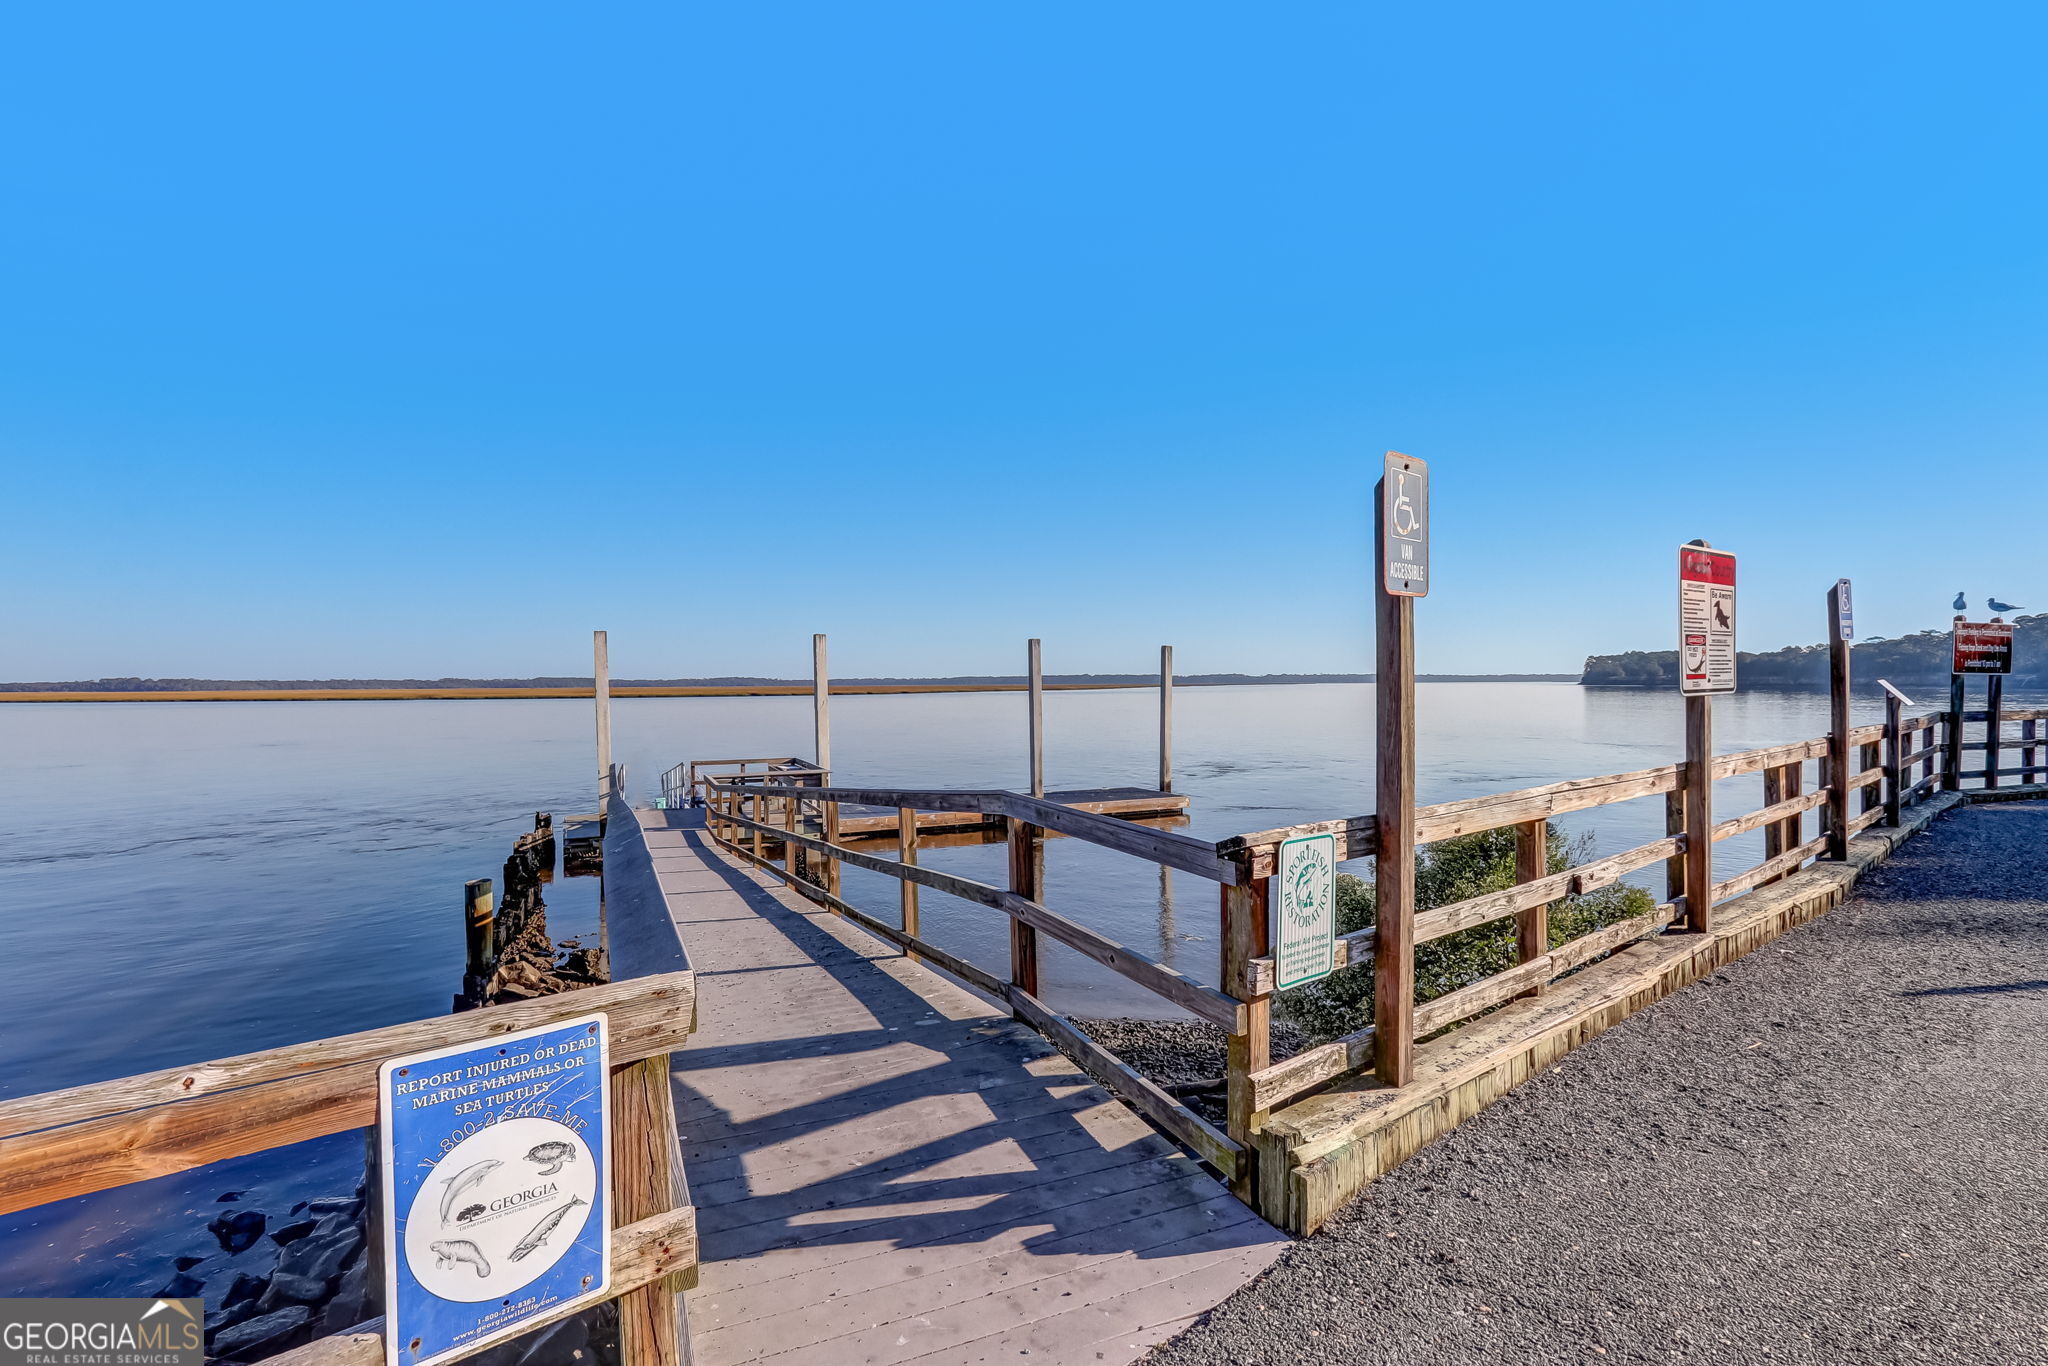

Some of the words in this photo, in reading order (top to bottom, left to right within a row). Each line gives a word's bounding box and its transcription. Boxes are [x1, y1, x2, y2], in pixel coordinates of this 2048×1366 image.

[1401, 543, 1413, 560] VAN
[1390, 561, 1424, 581] ACCESSIBLE
[1711, 590, 1718, 598] Be
[1719, 592, 1732, 600] Aware
[1284, 883, 1330, 928] RESTORATION
[1283, 940, 1300, 950] Federal
[1312, 931, 1329, 942] Project
[396, 1070, 463, 1096] REPORT
[466, 1053, 530, 1078] INJURED
[534, 1046, 554, 1060] OR
[558, 1036, 597, 1054] DEAD
[412, 1082, 479, 1110] MARINE
[482, 1062, 561, 1091] MAMMALS
[564, 1056, 585, 1069] OR
[455, 1099, 483, 1116] SEA
[485, 1081, 550, 1107] TURTLES
[490, 1182, 557, 1211] GEORGIA
[459, 1216, 494, 1231] DEPARTMENT
[504, 1206, 527, 1217] NATURAL
[529, 1196, 557, 1208] RESOURCES
[452, 1294, 558, 1342] www.georgiawildlife.com
[477, 1296, 536, 1325] 1-800-272-8363
